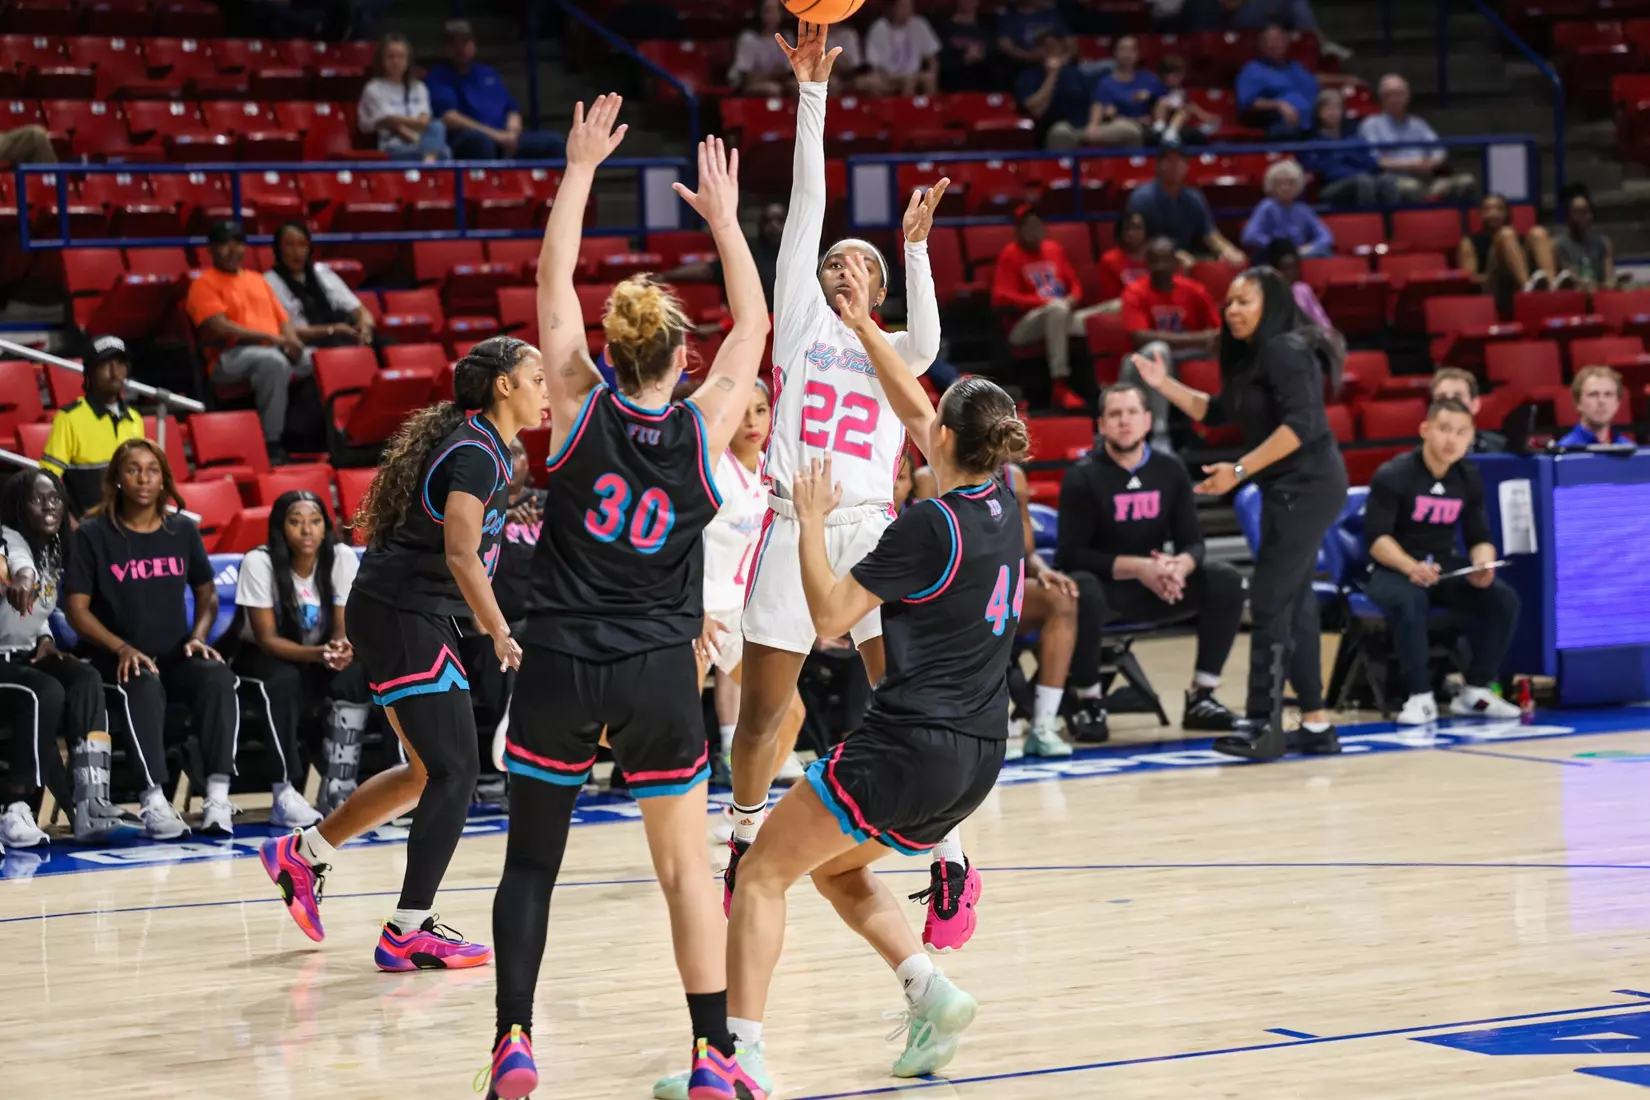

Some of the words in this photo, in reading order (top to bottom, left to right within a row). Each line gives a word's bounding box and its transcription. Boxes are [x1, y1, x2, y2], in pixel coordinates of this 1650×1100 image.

[627, 423, 661, 445] FIU
[800, 380, 880, 461] 22
[584, 472, 675, 554] 30
[1113, 490, 1160, 521] FIU
[1411, 495, 1463, 524] FIU
